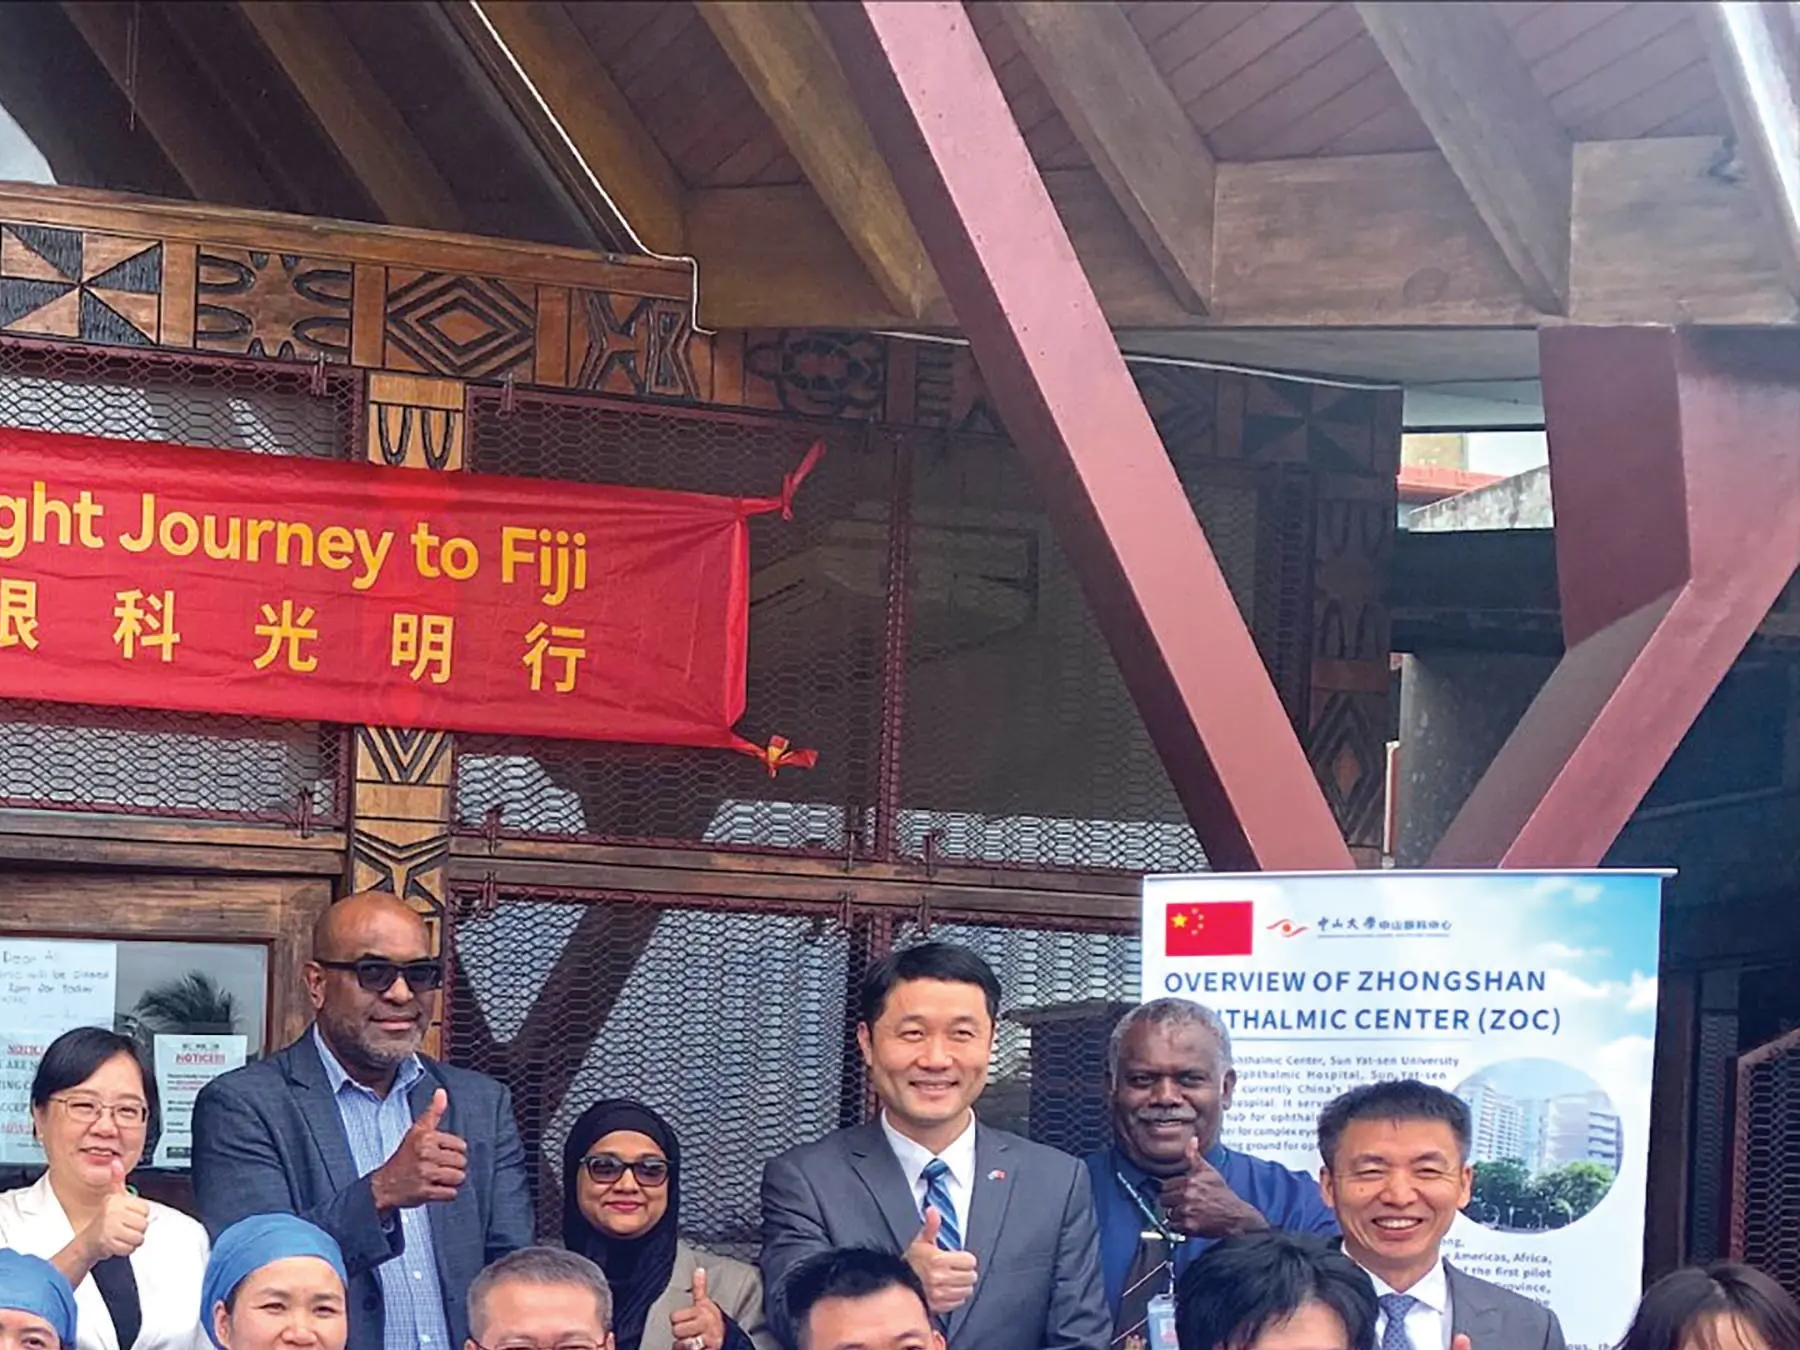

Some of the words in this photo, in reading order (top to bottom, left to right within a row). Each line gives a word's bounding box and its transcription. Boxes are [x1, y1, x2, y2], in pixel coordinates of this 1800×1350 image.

[118, 492, 393, 591] Journey
[412, 521, 479, 581] to
[500, 526, 587, 607] Fiji
[1165, 971, 1305, 992] OVERVIEW
[1313, 971, 1351, 992] OF
[1357, 969, 1545, 992] ZHONGSHAN
[1355, 1008, 1469, 1030] CENTER
[1478, 1007, 1561, 1035] (ZOC)
[1330, 1056, 1351, 1066] Sun
[1401, 1056, 1459, 1068] University
[1453, 1251, 1511, 1263] Americas,
[1513, 1252, 1552, 1264] Africa,
[1472, 1267, 1491, 1276] the
[1495, 1266, 1519, 1278] first
[1523, 1267, 1552, 1279] pilot
